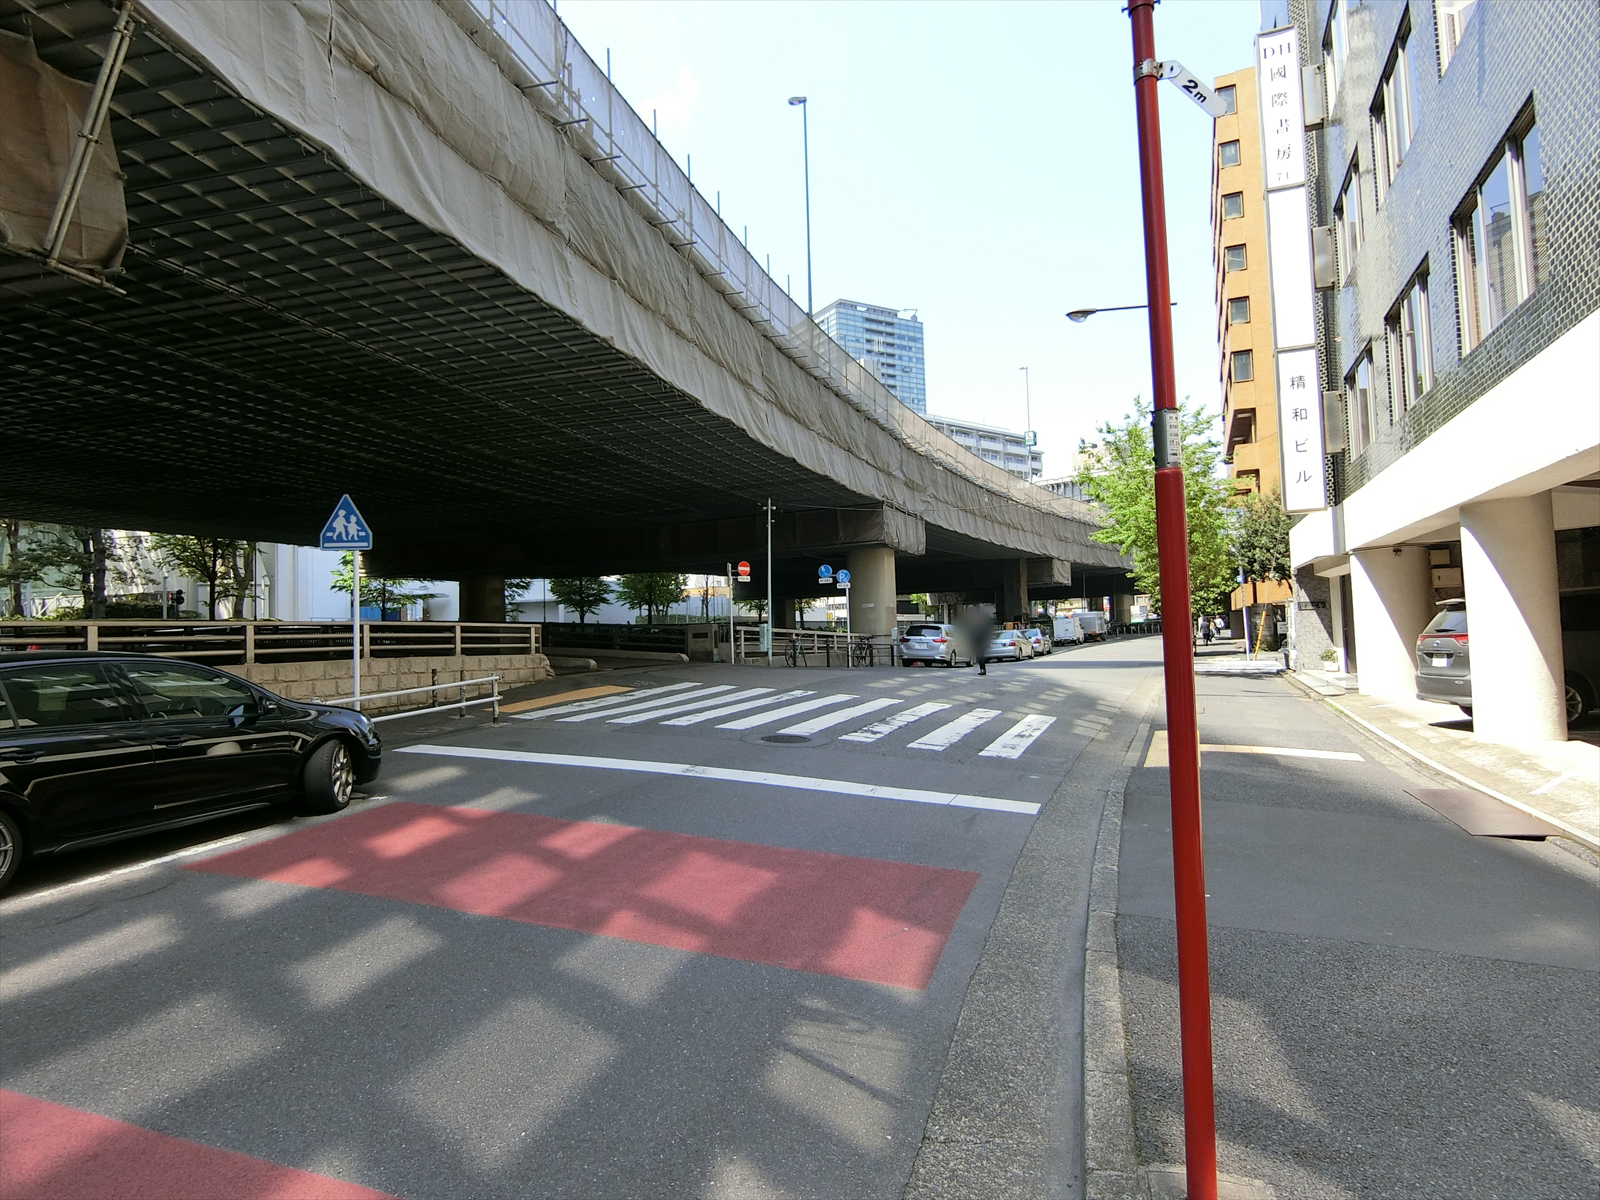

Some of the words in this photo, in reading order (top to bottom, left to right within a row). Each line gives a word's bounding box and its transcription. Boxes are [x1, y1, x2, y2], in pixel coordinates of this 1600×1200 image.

[1263, 42, 1291, 59] DH
[1182, 79, 1207, 104] 2m
[1289, 375, 1313, 484] 精和ビル
